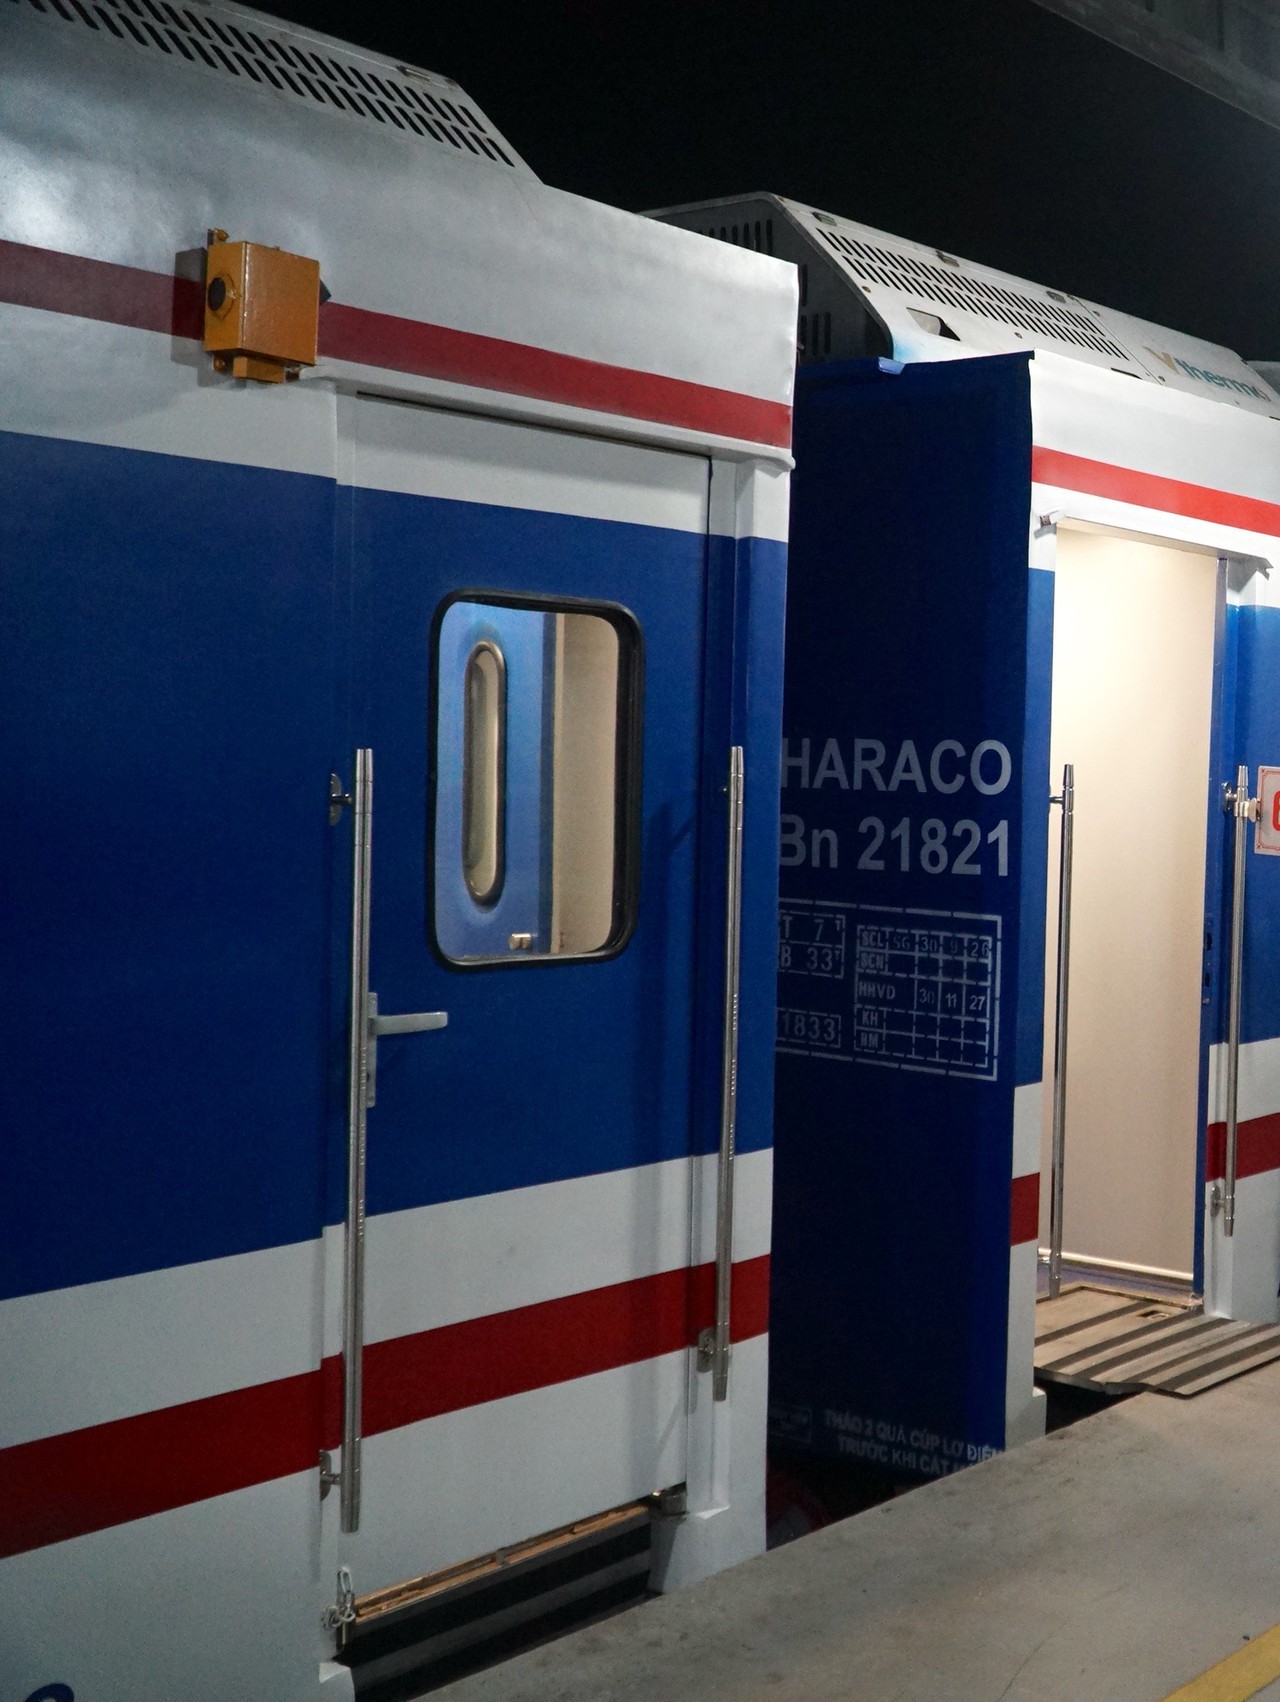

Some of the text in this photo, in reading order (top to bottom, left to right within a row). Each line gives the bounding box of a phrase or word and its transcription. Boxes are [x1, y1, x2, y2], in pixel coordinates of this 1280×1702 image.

[780, 738, 1012, 796] HARACO
[779, 814, 1009, 877] Bn 21821
[920, 936, 938, 952] 30
[969, 941, 989, 958] 26
[945, 991, 957, 1008] 11
[969, 994, 986, 1011] 27
[891, 1447, 916, 1469] KHI
